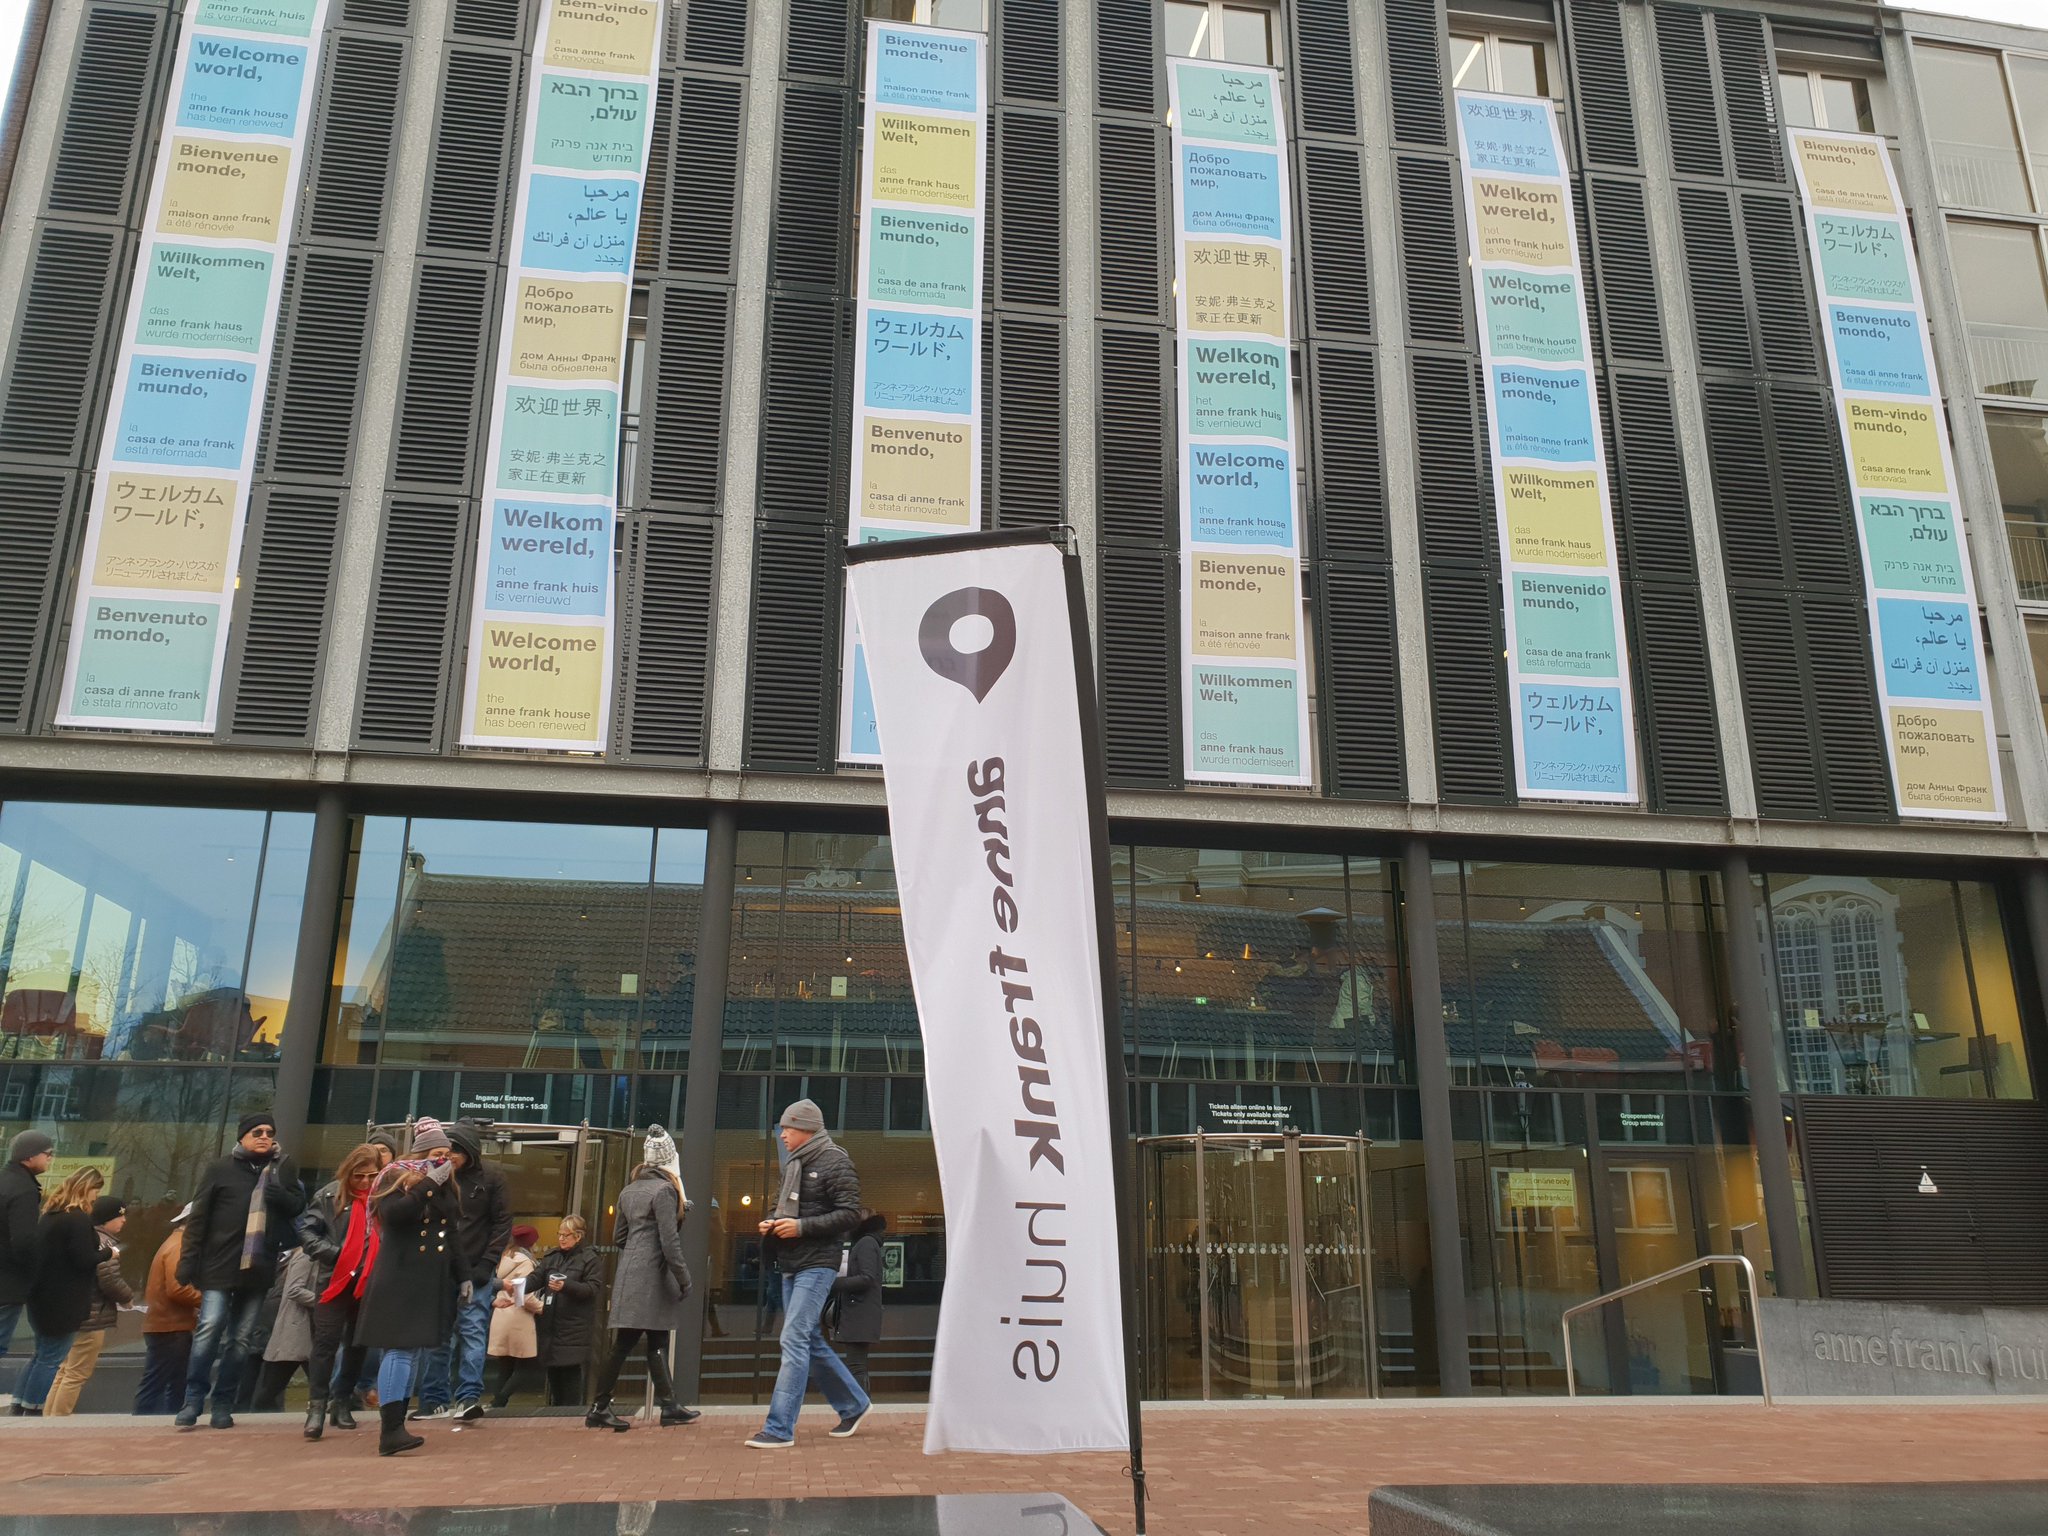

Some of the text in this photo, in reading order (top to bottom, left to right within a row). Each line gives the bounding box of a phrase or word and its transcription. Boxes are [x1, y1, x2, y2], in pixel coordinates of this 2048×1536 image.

[560, 0, 648, 15] Bem-vindo
[557, 9, 619, 26] mundo,
[885, 34, 968, 53] Bienvenue
[197, 40, 299, 65] Welcome
[884, 48, 943, 63] monde,
[194, 61, 262, 82] world,
[187, 103, 289, 120] anne frank house
[881, 117, 970, 137] Willkommen
[880, 130, 918, 146] Welt,
[179, 143, 278, 164] Bienvenue
[1802, 139, 1876, 156] Bienvenido
[1188, 151, 1230, 166] Добро
[1805, 152, 1856, 166] mundo,
[176, 161, 246, 179] monde,
[1189, 165, 1267, 180] пожаловать
[1189, 178, 1219, 189] мир,
[1479, 182, 1558, 204] Welkom
[1481, 204, 1555, 224] wereld,
[880, 214, 969, 234] Bienvenido
[879, 231, 939, 247] mundo,
[159, 250, 265, 271] Willkommen
[156, 264, 200, 282] Welt,
[524, 284, 574, 301] Добро
[1487, 274, 1571, 294] Welcome
[524, 300, 614, 314] пожаловать
[1490, 294, 1545, 313] world,
[522, 314, 556, 328] мир,
[1835, 310, 1911, 328] Benvenuto
[1837, 326, 1890, 342] mondo,
[1195, 346, 1279, 368] Welkom
[140, 362, 247, 383] Bienvenido
[1195, 368, 1276, 390] wereld,
[1499, 371, 1580, 389] Bienvenue
[137, 381, 208, 398] mundo,
[1501, 388, 1556, 405] monde,
[1850, 404, 1927, 422] Bem-vindo
[871, 424, 963, 444] Benvenuto
[1852, 421, 1907, 436] mundo,
[870, 442, 934, 459] mondo,
[1195, 451, 1285, 470] Welcome
[1860, 464, 1931, 476] casa anne frank
[1195, 470, 1258, 489] world,
[1508, 472, 1595, 489] Willkommen
[868, 492, 965, 507] casa di anne frank
[1509, 486, 1546, 502] Welt,
[503, 507, 603, 531] Welkom
[500, 536, 594, 559] wereld,
[1199, 559, 1286, 576] Bienvenue
[1199, 577, 1261, 594] monde,
[1520, 579, 1606, 596] Bienvenido
[1522, 596, 1579, 613] mundo,
[96, 605, 207, 626] Benvenuto
[92, 627, 170, 646] mondo,
[489, 629, 597, 652] Welcome
[487, 653, 560, 676] world,
[1198, 672, 1292, 689] Willkommen
[486, 692, 505, 704] the
[1198, 687, 1238, 704] Welt,
[484, 705, 591, 719] anne frank house
[484, 716, 586, 731] has been renewed
[1896, 713, 1937, 729] Добро
[1200, 731, 1218, 741] das
[1897, 730, 1975, 743] пожаловать
[1199, 742, 1284, 755] anne frank haus
[1899, 744, 1929, 757] мир,
[1200, 755, 1295, 768] wurde moderniseert
[1905, 781, 1988, 794] дом Анны Франк
[475, 1094, 499, 1102] Ingang
[1222, 1118, 1280, 1126] www.annefrank.org
[1233, 1111, 1246, 1119] only
[1622, 1119, 1639, 1127] Group
